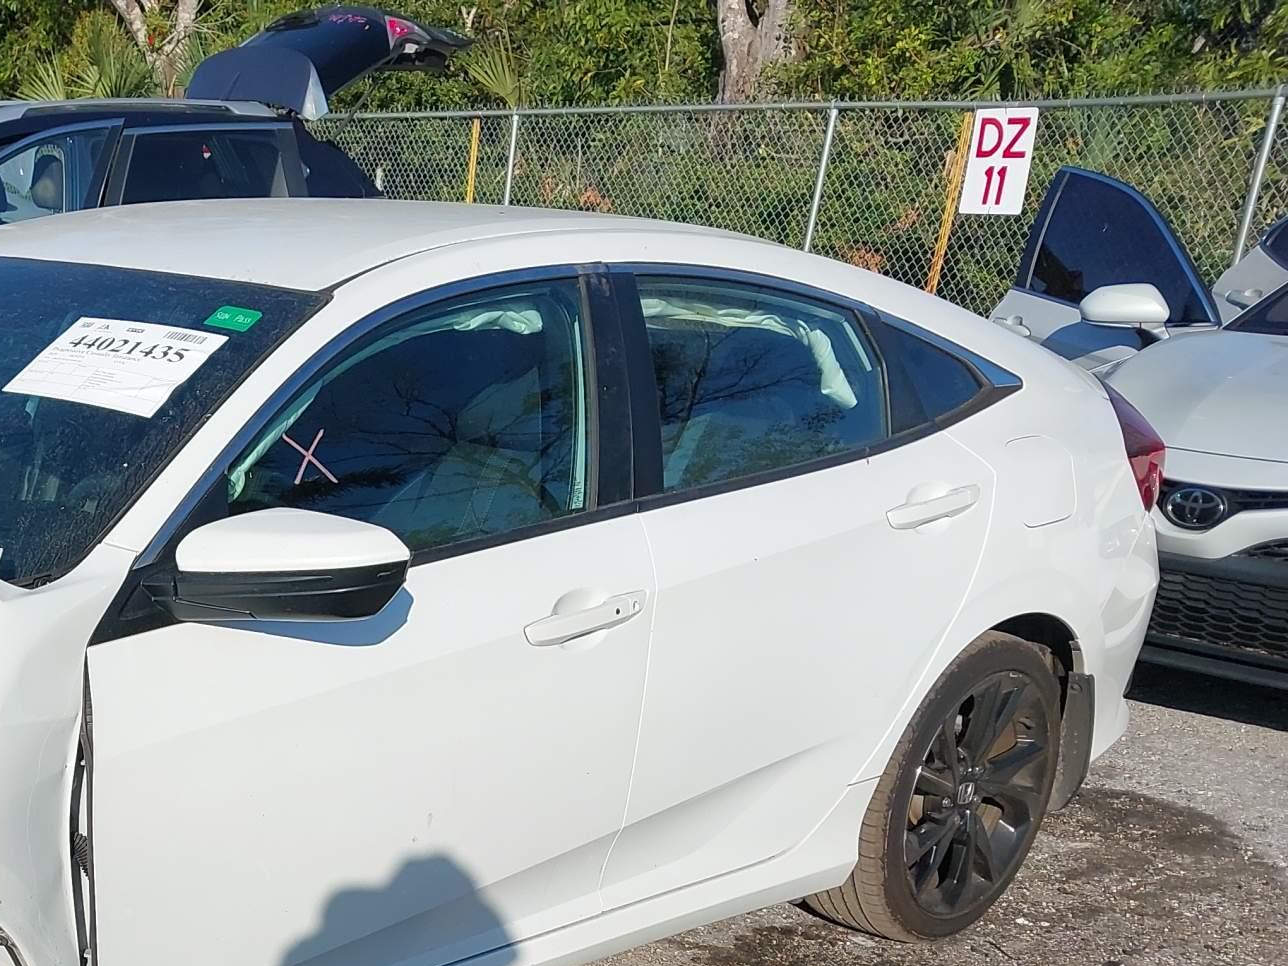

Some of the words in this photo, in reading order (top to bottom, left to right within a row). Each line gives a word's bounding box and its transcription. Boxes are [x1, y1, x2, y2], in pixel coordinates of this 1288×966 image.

[976, 117, 1031, 158] DZ
[981, 166, 1008, 205] 11
[69, 334, 191, 363] 44021435
